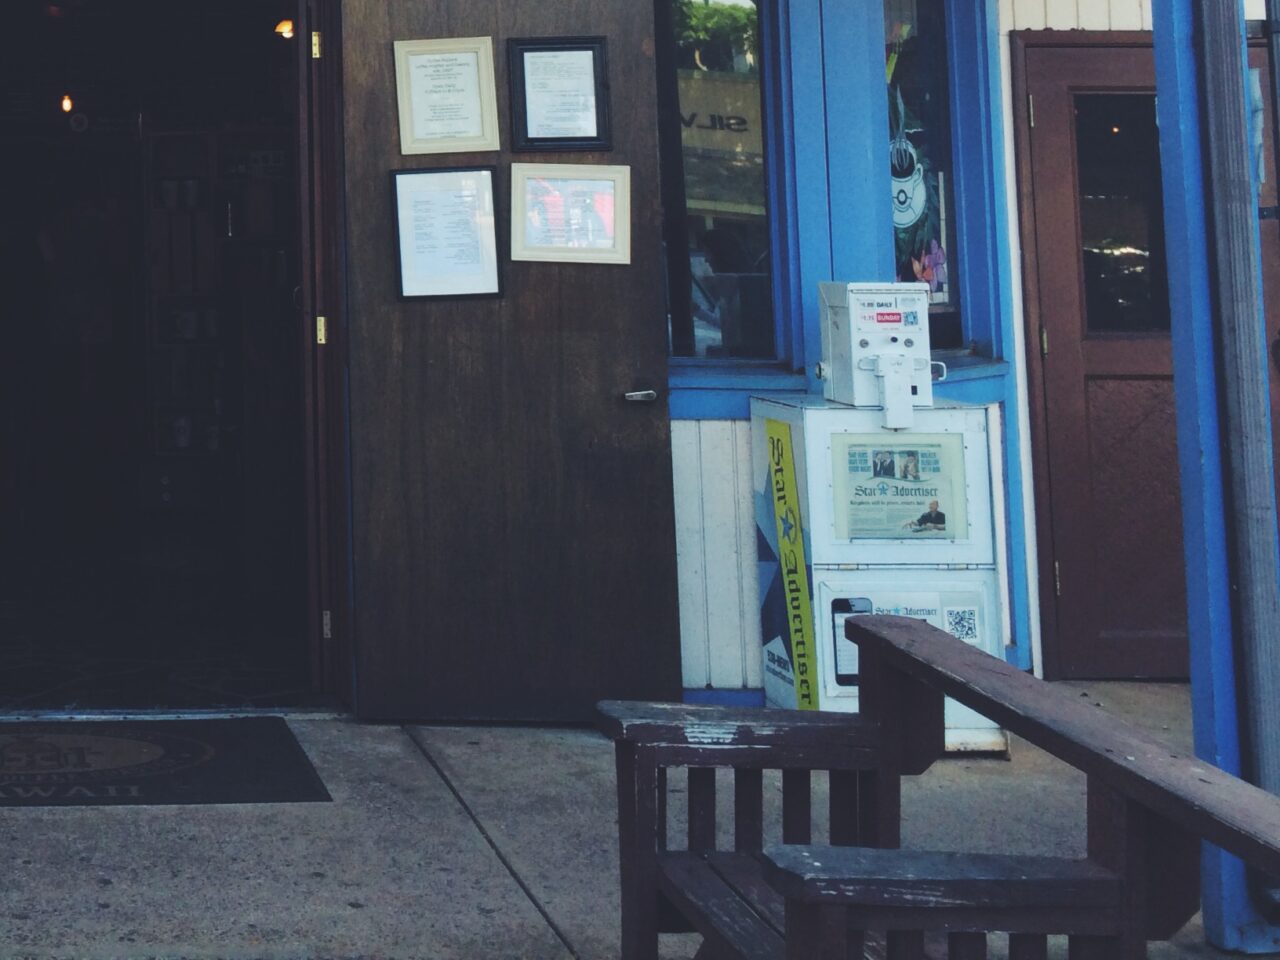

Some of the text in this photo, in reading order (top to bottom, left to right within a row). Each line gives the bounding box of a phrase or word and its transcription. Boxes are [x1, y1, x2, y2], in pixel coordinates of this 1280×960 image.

[854, 485, 938, 497] Star Advertiser
[769, 436, 811, 706] Star Advertiser
[874, 607, 937, 616] Star Advertiser
